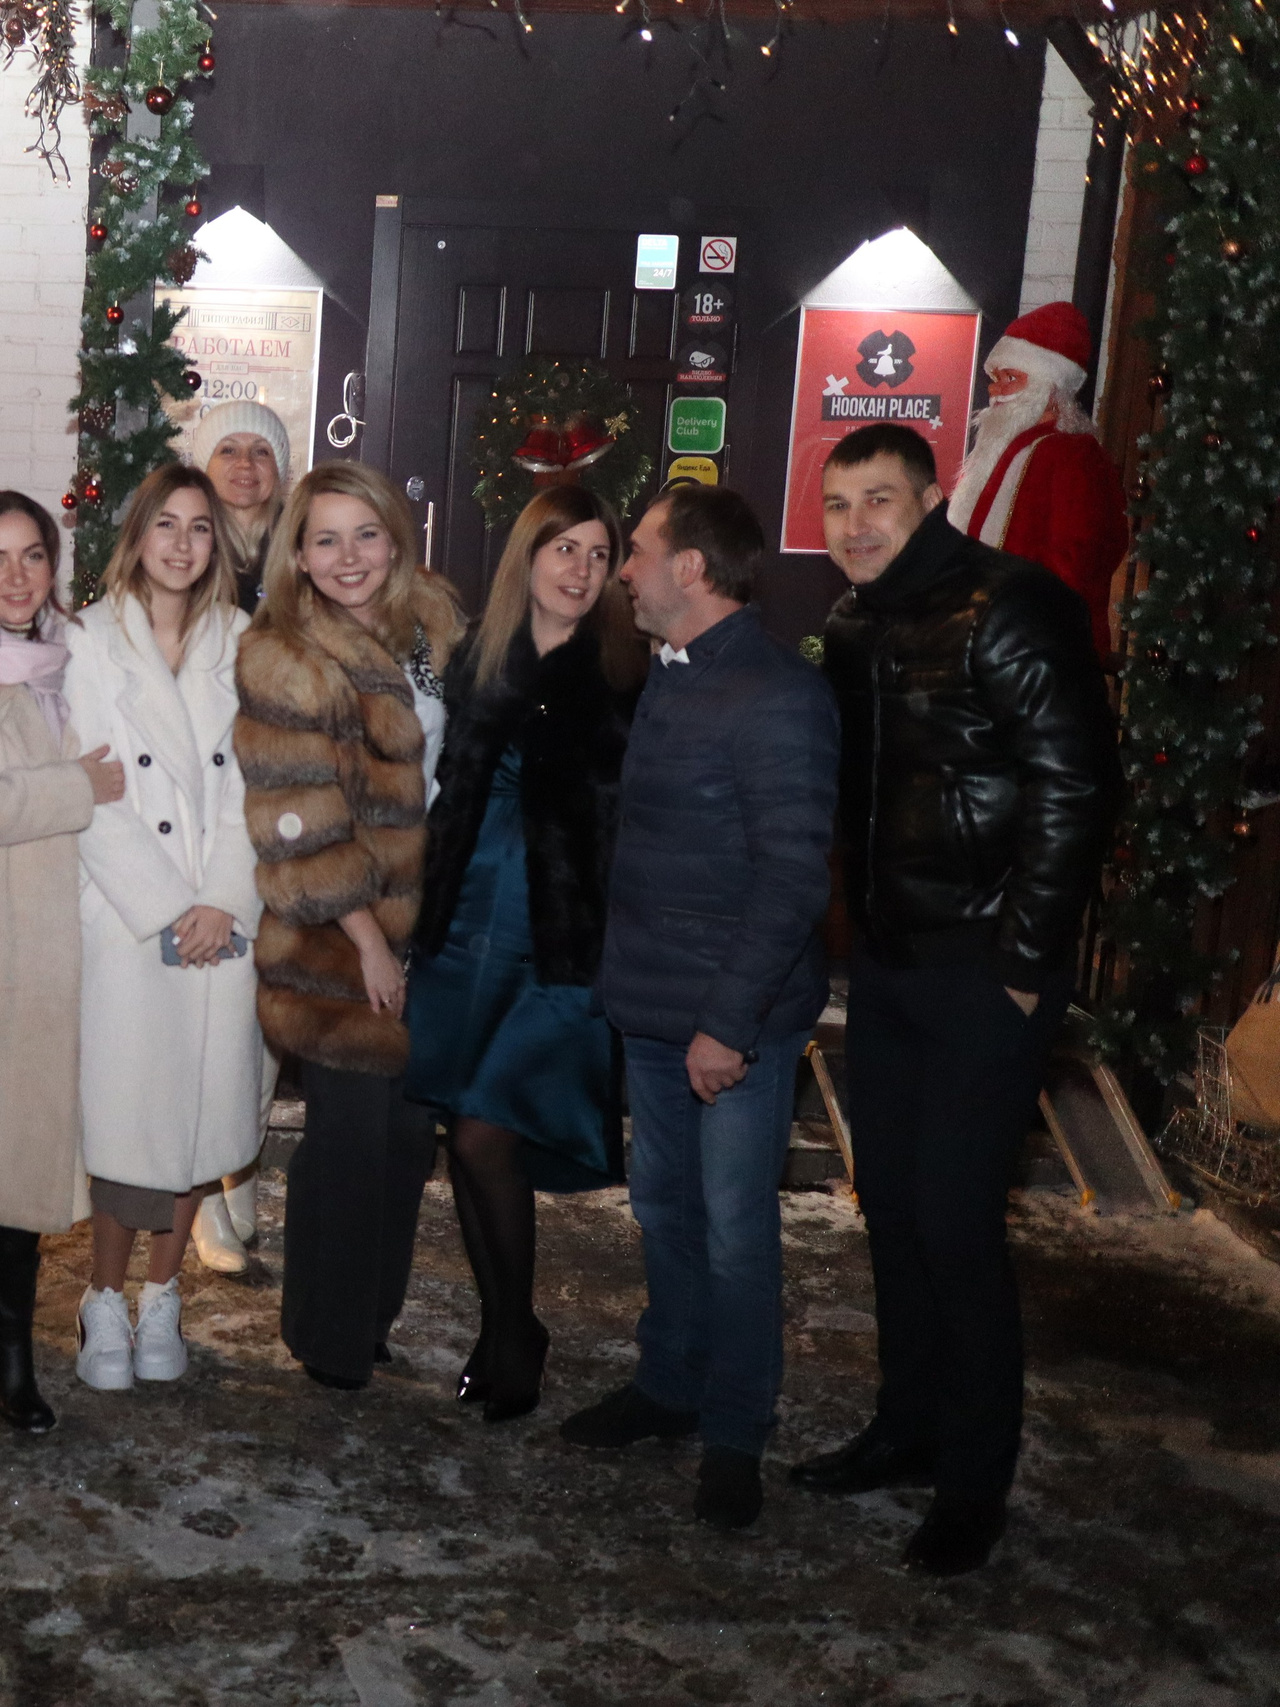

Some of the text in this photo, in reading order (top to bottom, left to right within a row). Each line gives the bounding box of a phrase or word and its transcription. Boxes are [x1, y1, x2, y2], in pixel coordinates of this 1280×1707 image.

[652, 268, 673, 278] 24/7
[694, 293, 724, 315] 18+
[201, 314, 264, 325] ТИПОГРАФИЯ
[691, 315, 721, 323] ТОЛЬКО
[173, 336, 292, 358] РАБОТАЕМ
[201, 379, 258, 400] 12:00
[831, 397, 932, 419] HOOKAH PLACE
[677, 416, 717, 428] Delivery
[676, 426, 700, 436] Club
